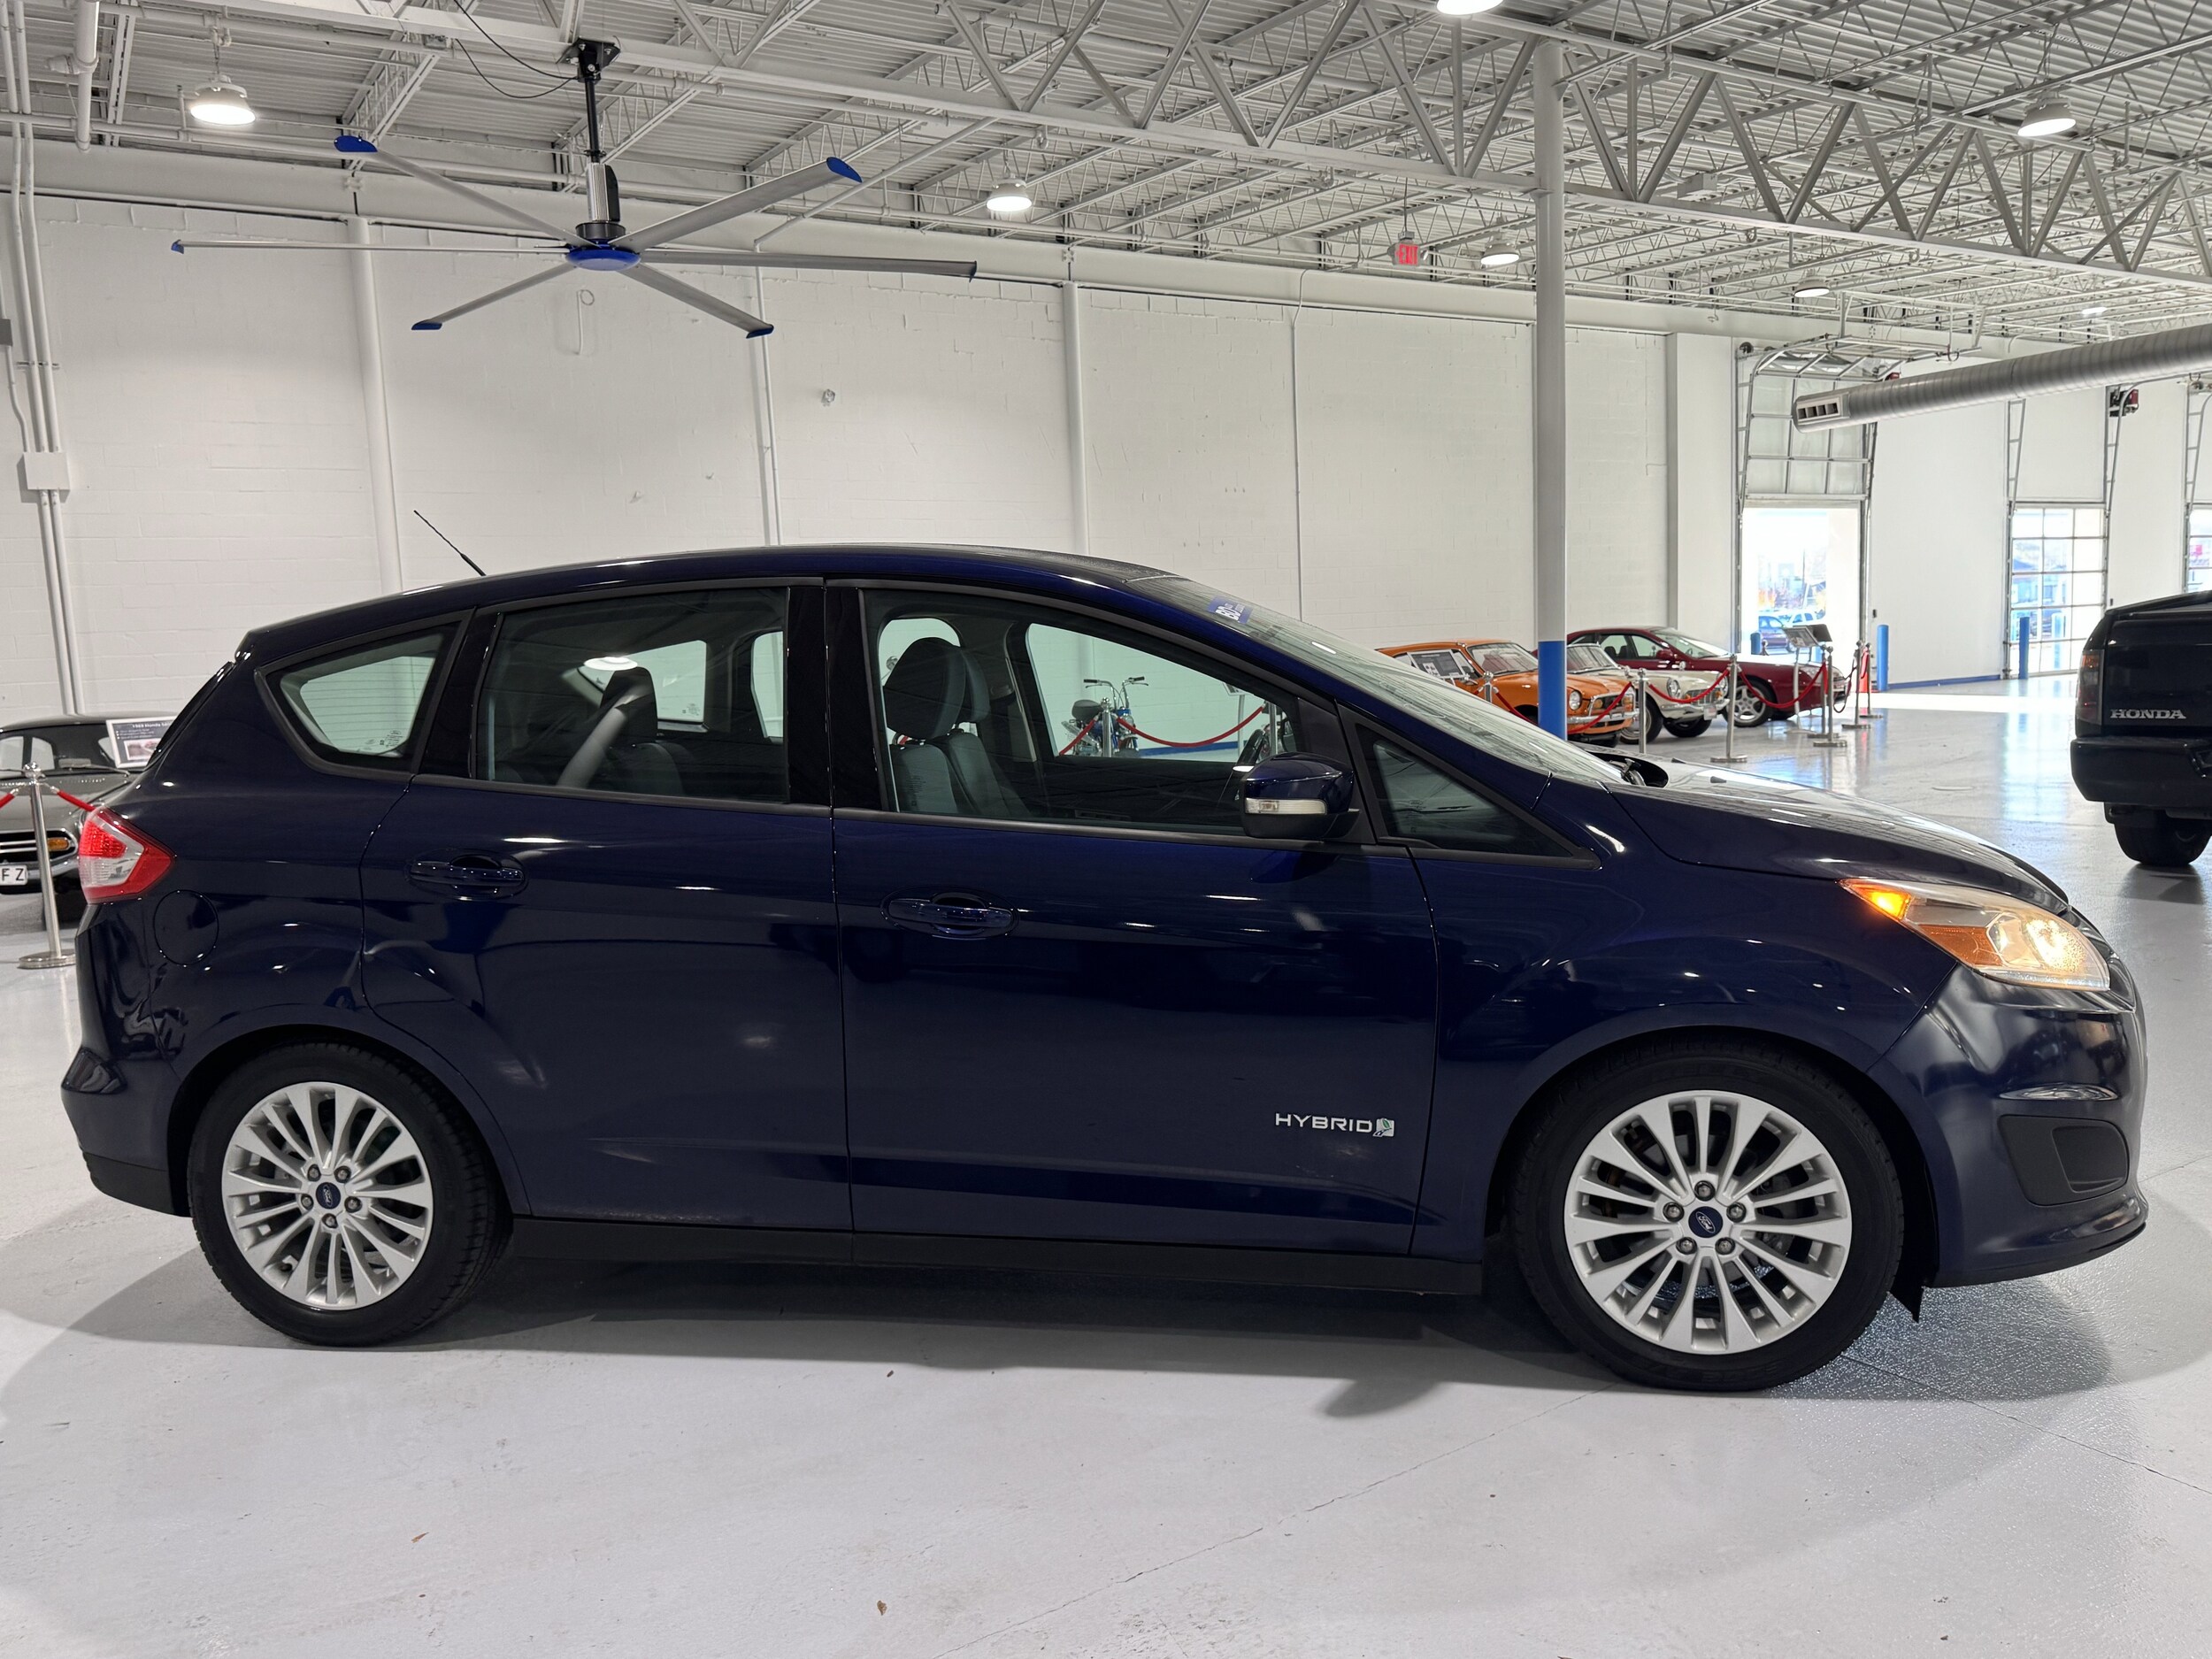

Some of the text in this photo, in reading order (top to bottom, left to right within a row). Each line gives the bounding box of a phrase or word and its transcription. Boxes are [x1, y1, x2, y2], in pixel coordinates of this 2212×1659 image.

[1399, 243, 1418, 265] EXIT
[2109, 709, 2186, 719] HONDA
[1275, 1112, 1372, 1133] HYBRID
